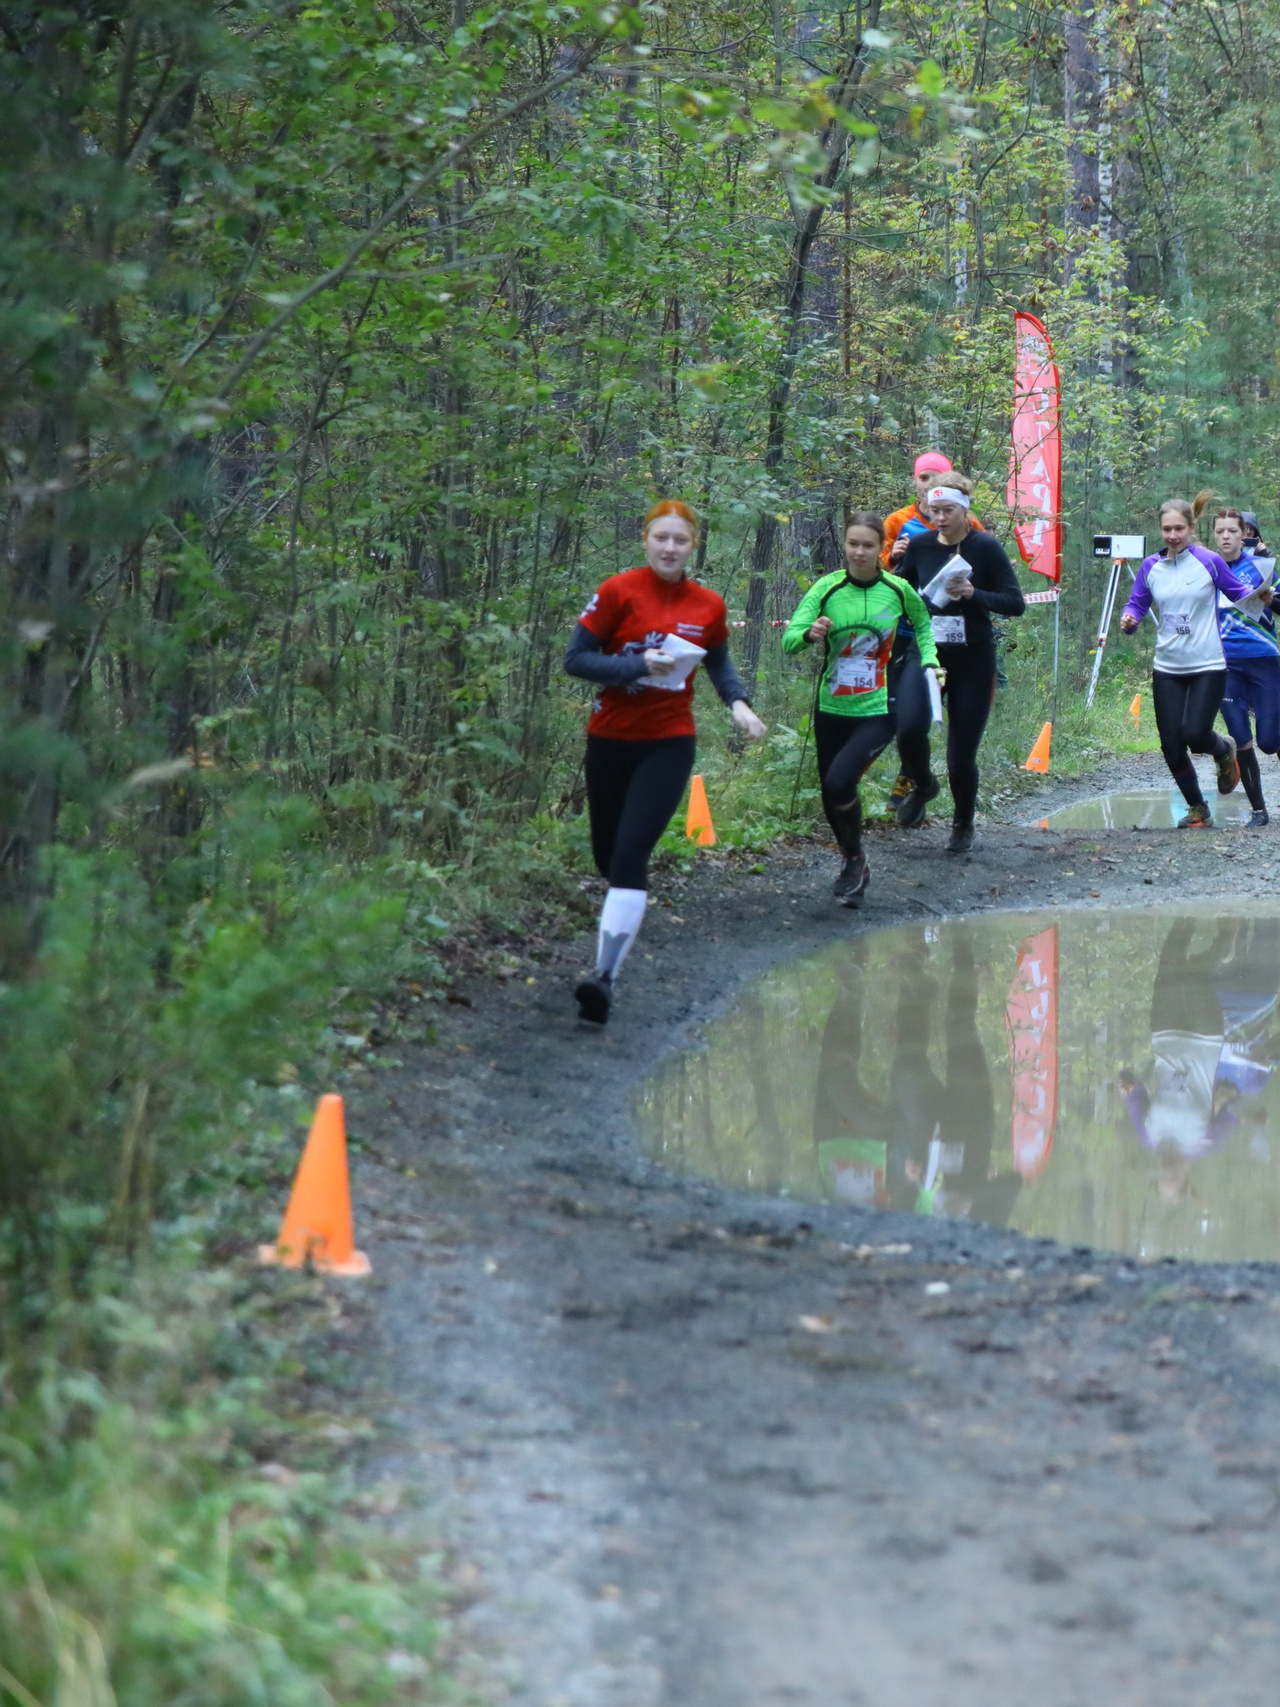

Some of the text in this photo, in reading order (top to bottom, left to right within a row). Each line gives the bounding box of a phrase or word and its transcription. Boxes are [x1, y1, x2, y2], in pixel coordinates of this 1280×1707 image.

[1175, 626, 1191, 635] 158
[945, 632, 963, 643] 159
[854, 676, 873, 688] 154
